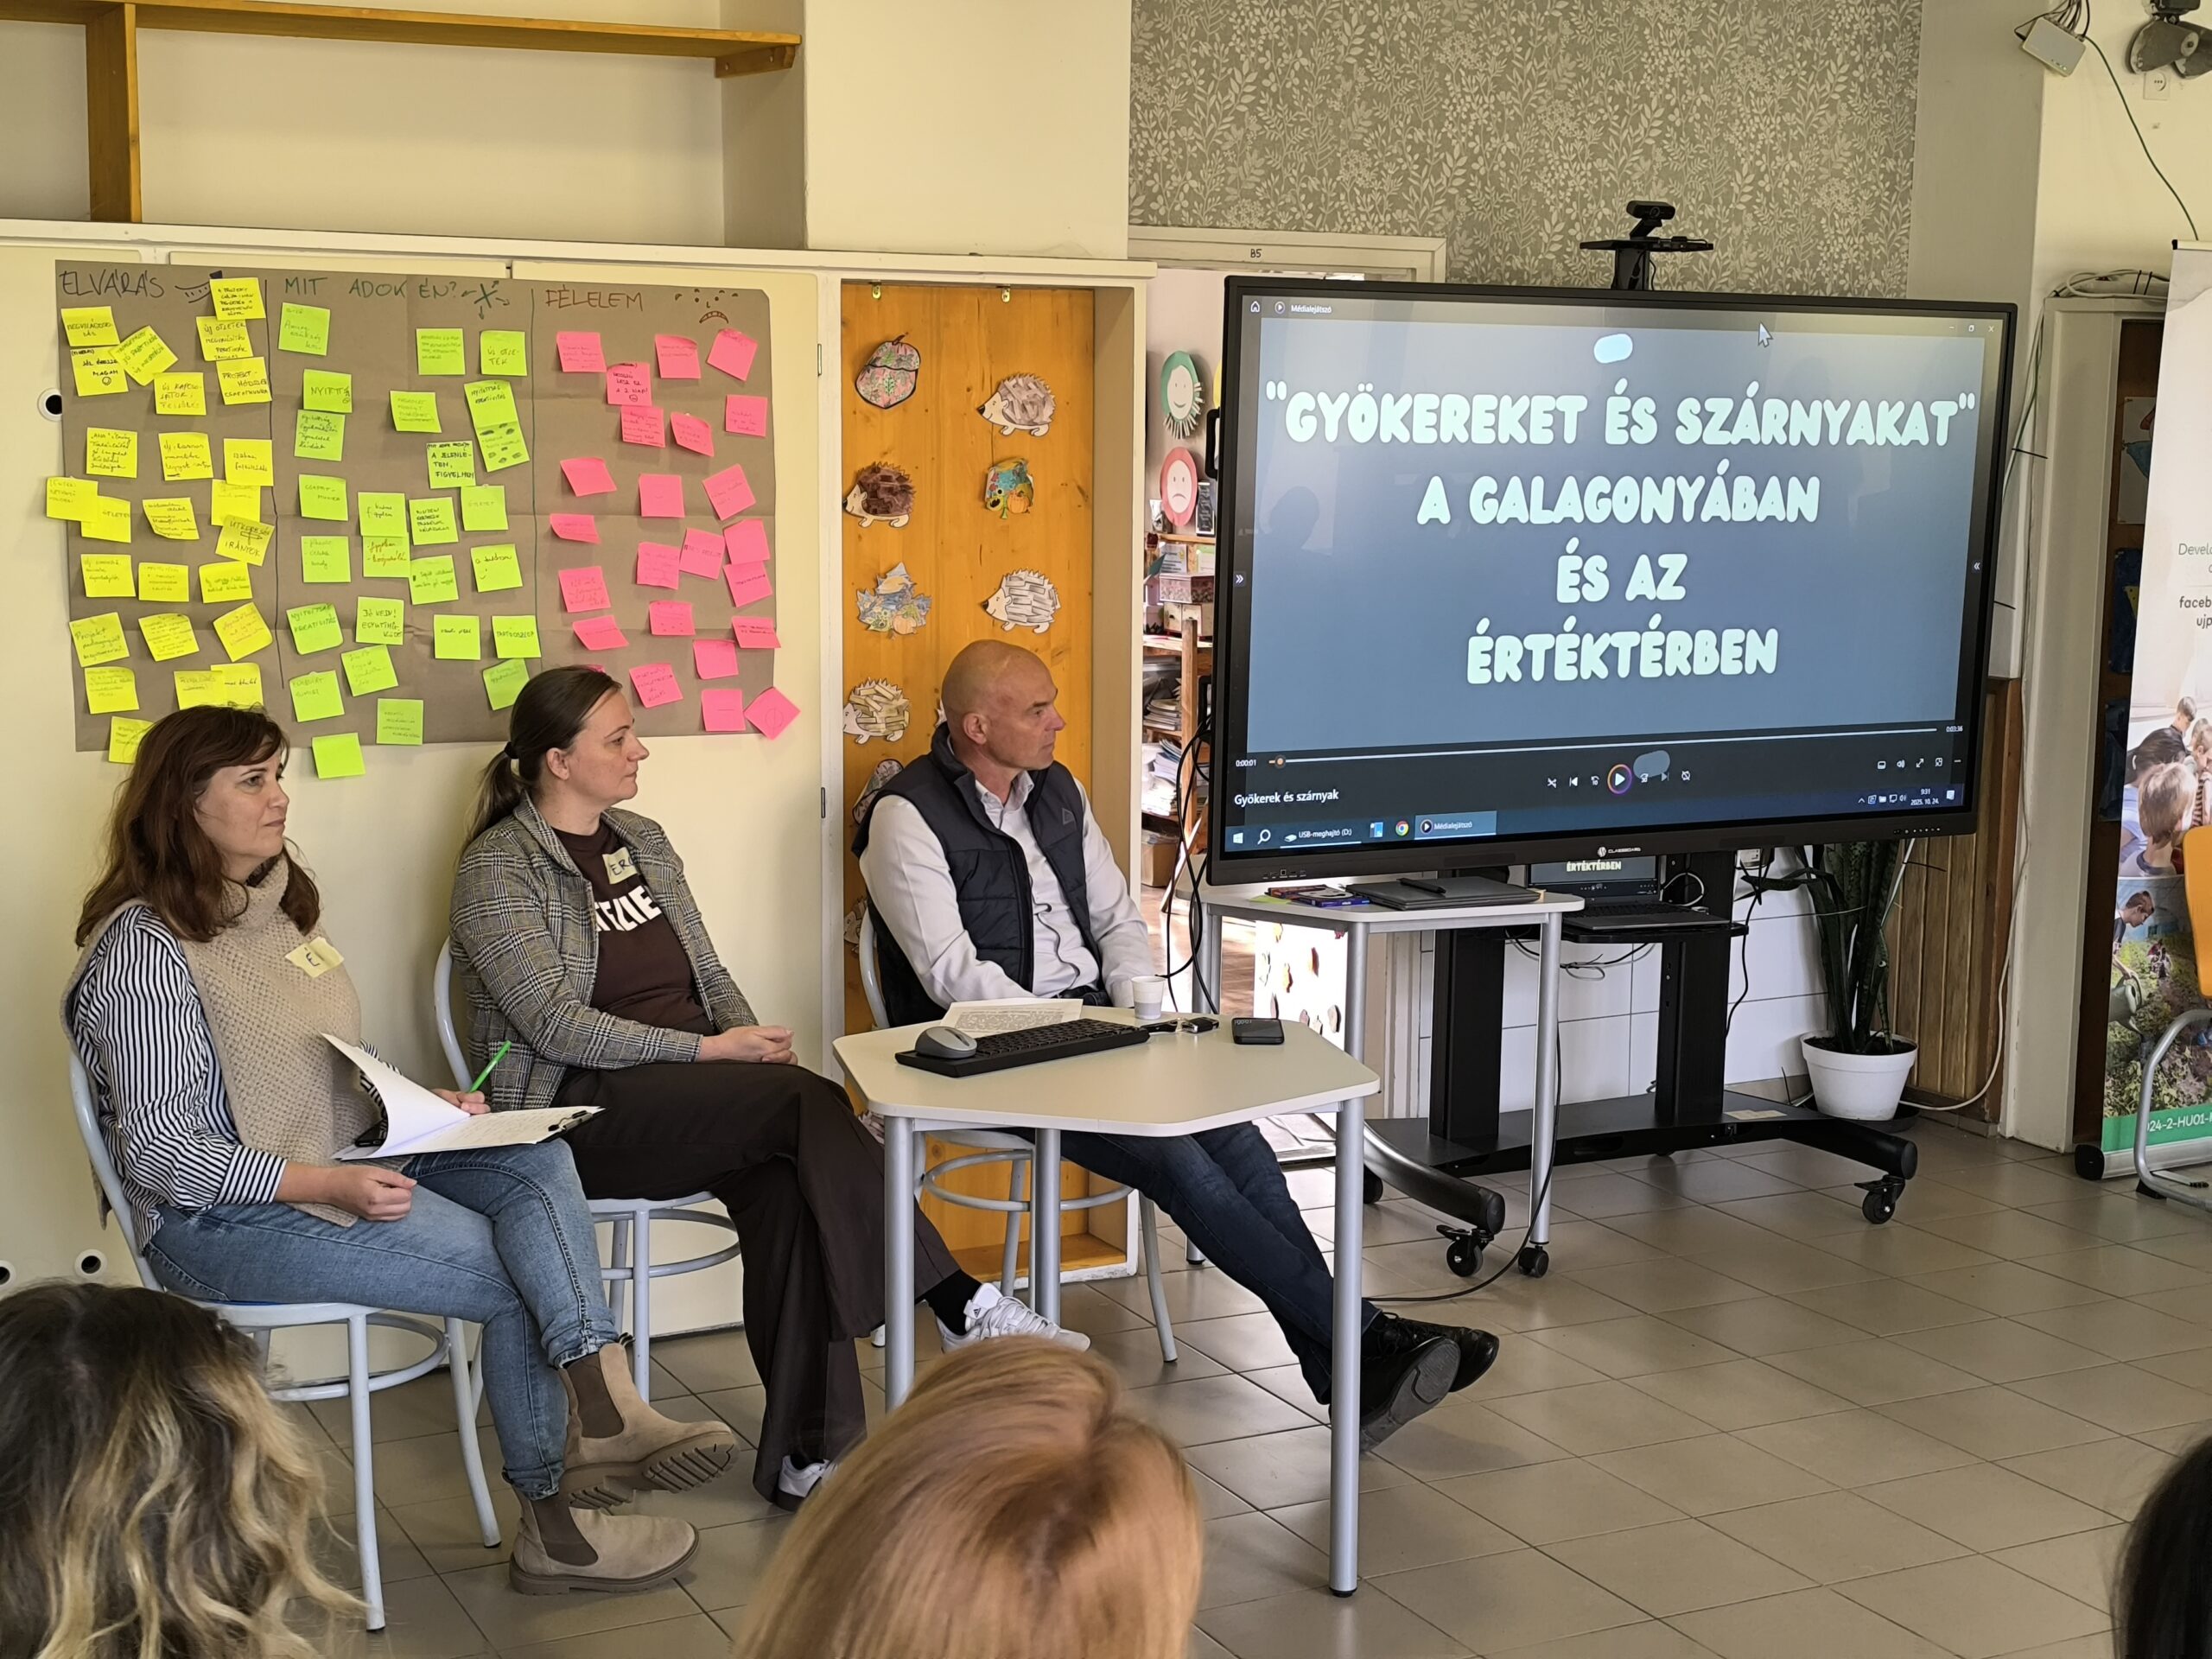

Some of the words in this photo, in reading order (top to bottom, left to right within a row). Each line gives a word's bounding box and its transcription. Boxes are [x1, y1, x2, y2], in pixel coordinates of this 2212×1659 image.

[59, 269, 165, 298] ELVÁRÁS
[284, 276, 328, 296] MIT
[348, 278, 408, 298] ADOK
[545, 284, 644, 311] FÉLELEM
[1266, 380, 1588, 445] "GYÖKEREKET
[1605, 378, 1659, 446] ÉS
[1675, 380, 1976, 447] SZÁRNYAKAT"
[1416, 475, 1452, 525] A
[1469, 458, 1821, 525] GALAGONYÁBAN
[1556, 537, 1610, 604] ÉS
[1625, 553, 1688, 602] AZ
[1467, 613, 1779, 685] ÉRTÉKTÉRBEN
[1235, 792, 1281, 807] Gyökerek
[1283, 790, 1294, 802] és
[1296, 789, 1338, 803] szárnyak
[1567, 859, 1622, 872] ÉRTÉKTÉRBEN
[2147, 1113, 2212, 1132] 24-2-HU01-
